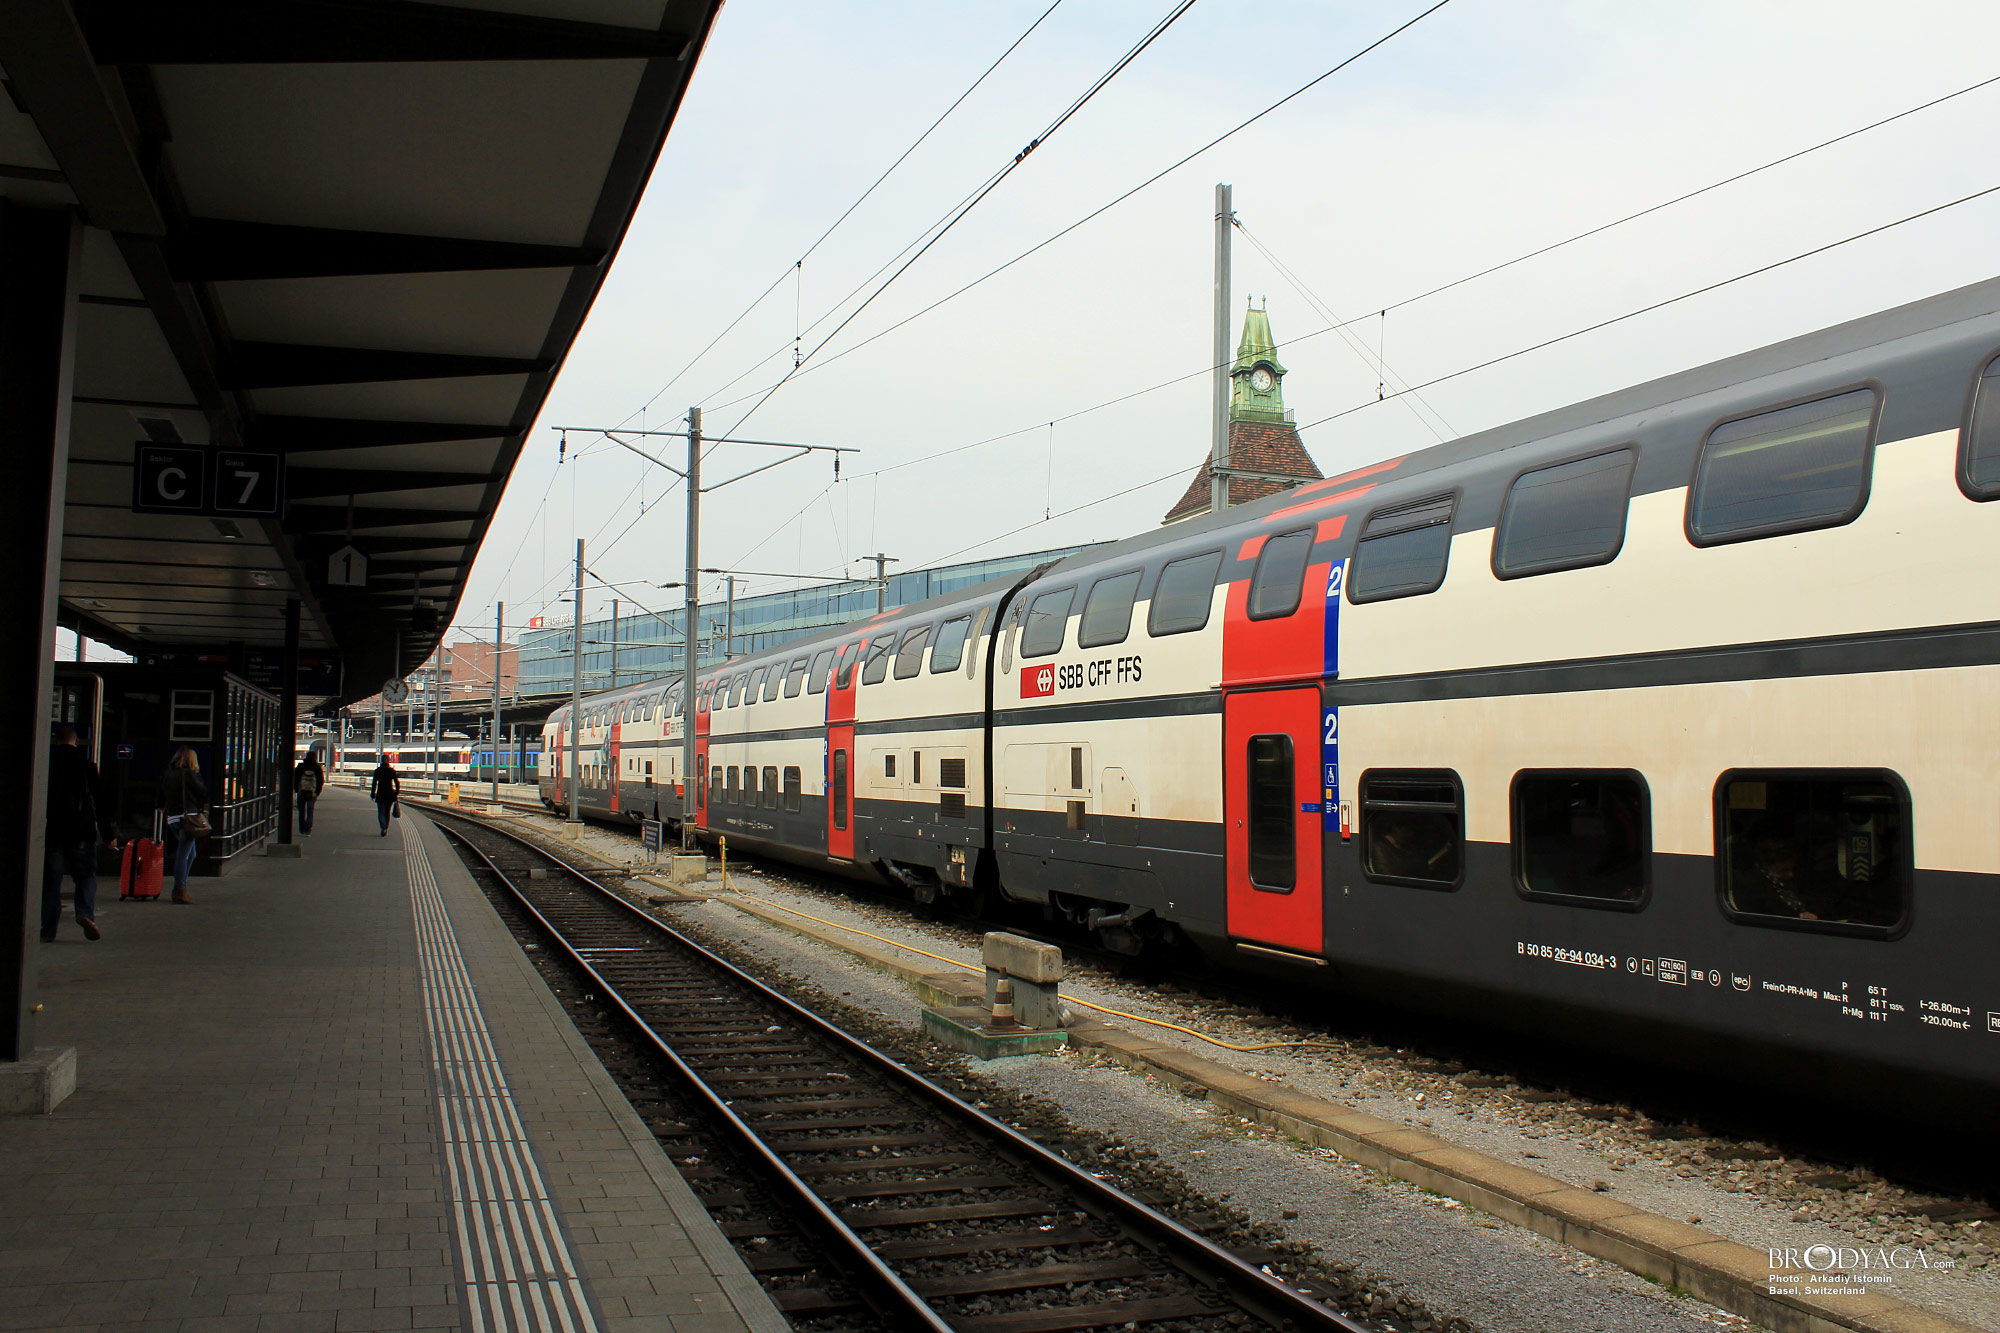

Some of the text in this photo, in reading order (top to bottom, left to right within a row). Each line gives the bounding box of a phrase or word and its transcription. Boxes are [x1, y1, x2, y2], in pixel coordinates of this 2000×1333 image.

[149, 454, 174, 463] Sektor
[225, 459, 245, 468] Gleis
[157, 467, 187, 501] C
[234, 471, 260, 504] 7
[342, 553, 352, 583] 1
[1326, 566, 1342, 597] 2
[1058, 655, 1142, 690] SBB CFF FFS
[1324, 713, 1338, 744] 2
[1517, 942, 1617, 969] B 50 85 26-94 034-3
[1645, 963, 1650, 972] 4
[1712, 973, 1718, 982] D
[1841, 982, 1887, 996] P 65 T
[1823, 991, 1842, 1003] Max:
[1842, 994, 1849, 1003] R
[1870, 998, 1880, 1007] 81
[1881, 1000, 1888, 1009] T
[1889, 1003, 1905, 1012] 135%
[1928, 1001, 1961, 1015] 26.80m
[1869, 1011, 1880, 1021] 111
[1881, 1012, 1888, 1022] T
[1928, 1015, 1962, 1029] 20.00m
